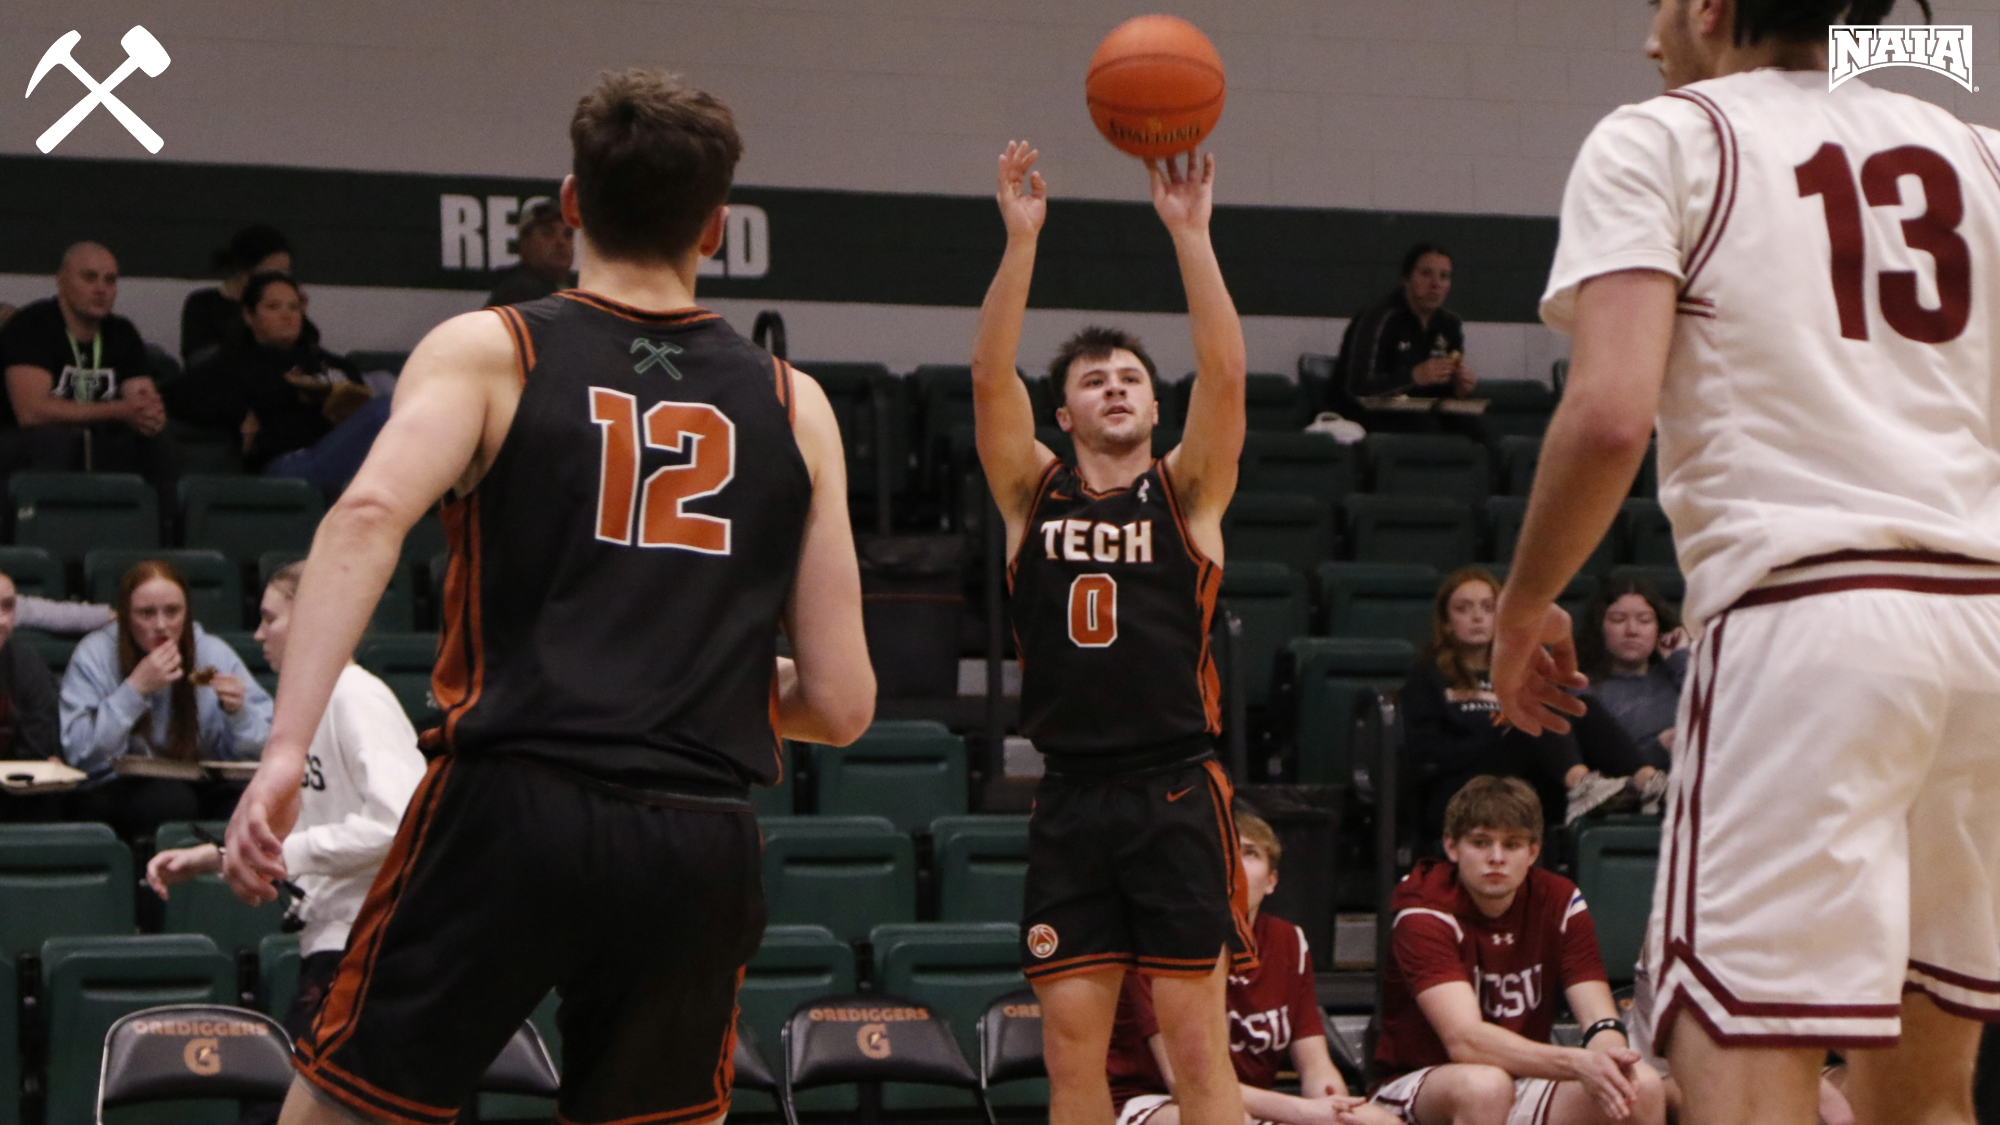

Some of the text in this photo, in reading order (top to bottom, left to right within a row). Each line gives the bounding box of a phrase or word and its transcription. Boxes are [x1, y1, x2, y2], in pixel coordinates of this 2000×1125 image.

[1794, 141, 1972, 344] 13
[588, 386, 736, 555] 12
[1040, 518, 1154, 563] TECH
[1068, 573, 1118, 648] 0
[131, 1020, 269, 1037] OREDIGGERS
[809, 1006, 929, 1022] OREDIGGERS
